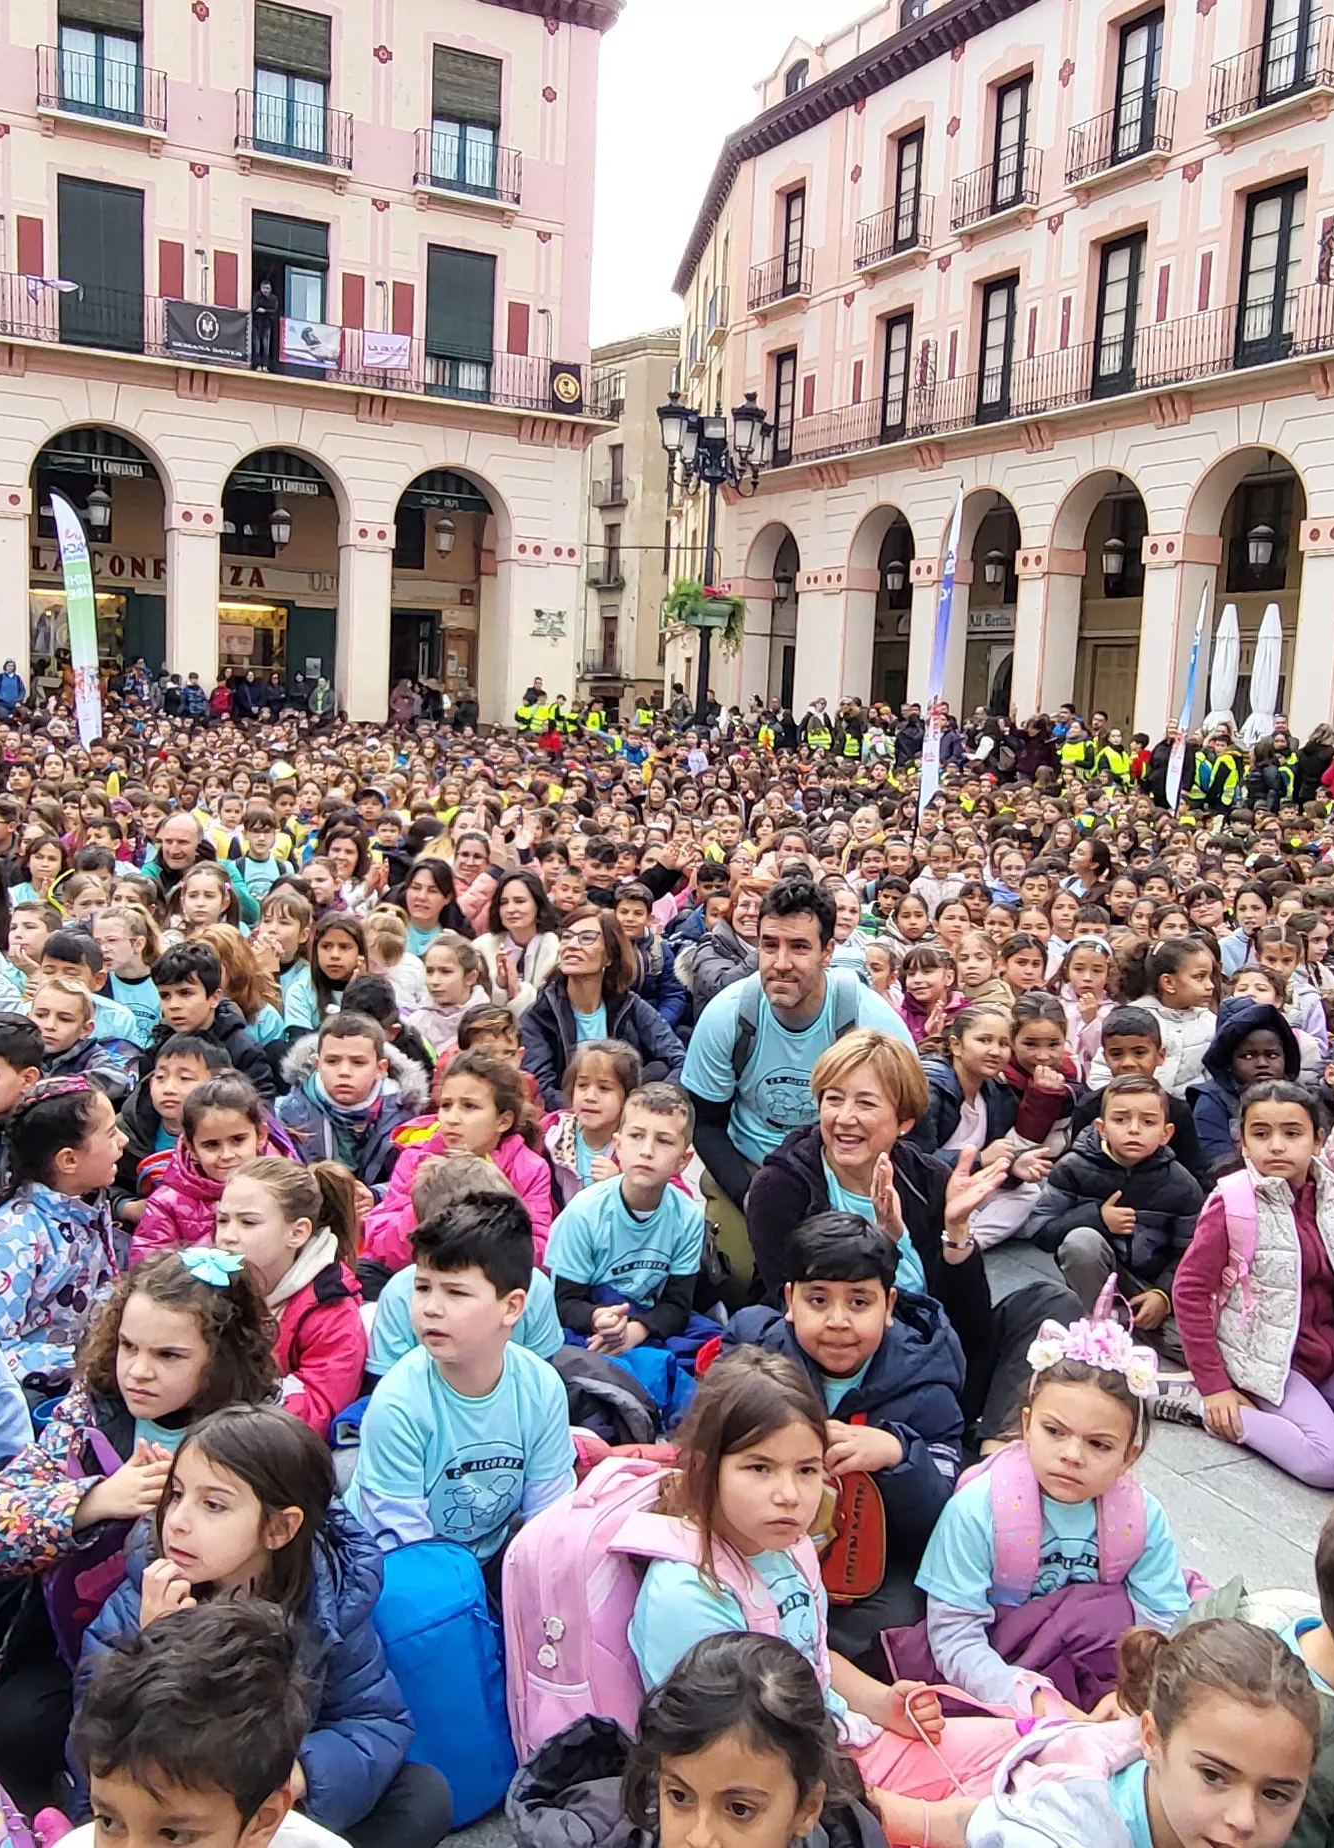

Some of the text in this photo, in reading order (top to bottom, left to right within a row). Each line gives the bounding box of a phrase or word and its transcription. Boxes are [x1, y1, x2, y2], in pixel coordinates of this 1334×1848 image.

[91, 458, 144, 478] LA CONFIANZA
[272, 478, 281, 491] LA
[470, 1458, 522, 1472] ALCORAZ
